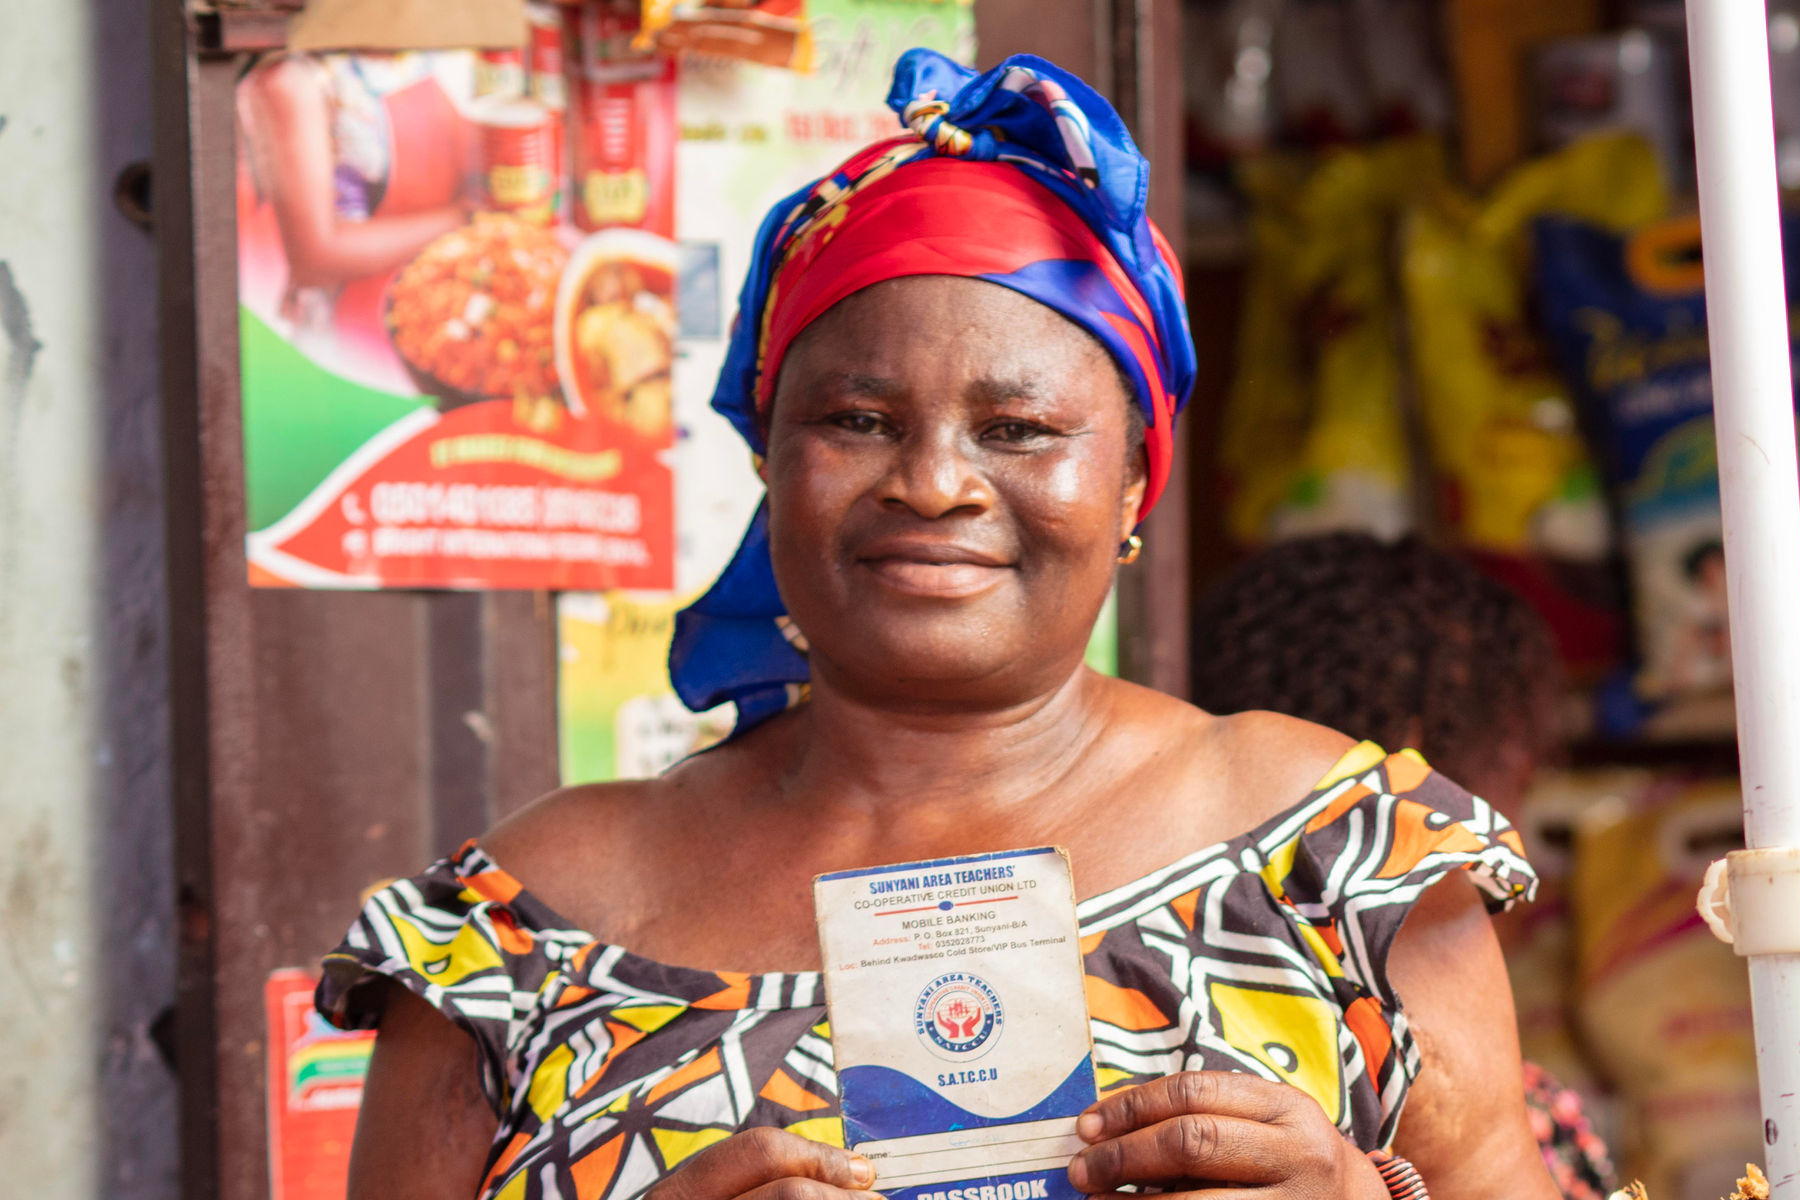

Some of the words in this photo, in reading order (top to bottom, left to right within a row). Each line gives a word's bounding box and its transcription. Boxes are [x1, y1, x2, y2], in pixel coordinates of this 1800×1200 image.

[854, 892, 934, 910] CO-OPERATIVE
[937, 887, 976, 900] CREDIT
[980, 883, 1014, 895] UNION
[1017, 880, 1037, 890] LTD
[869, 877, 920, 895] SUNYANI
[923, 873, 952, 888] AREA
[902, 917, 943, 930] MOBILE
[946, 911, 996, 925] BANKING
[935, 930, 952, 938] Box
[860, 957, 891, 968] Behind
[946, 947, 966, 957] Cold
[968, 942, 1008, 955] Store/VIP
[1010, 940, 1027, 950] Bus
[1030, 936, 1066, 947] Terminal
[916, 986, 934, 1035] SUNYANI
[935, 974, 963, 987] AREA
[968, 975, 1002, 1025] TEACHERS
